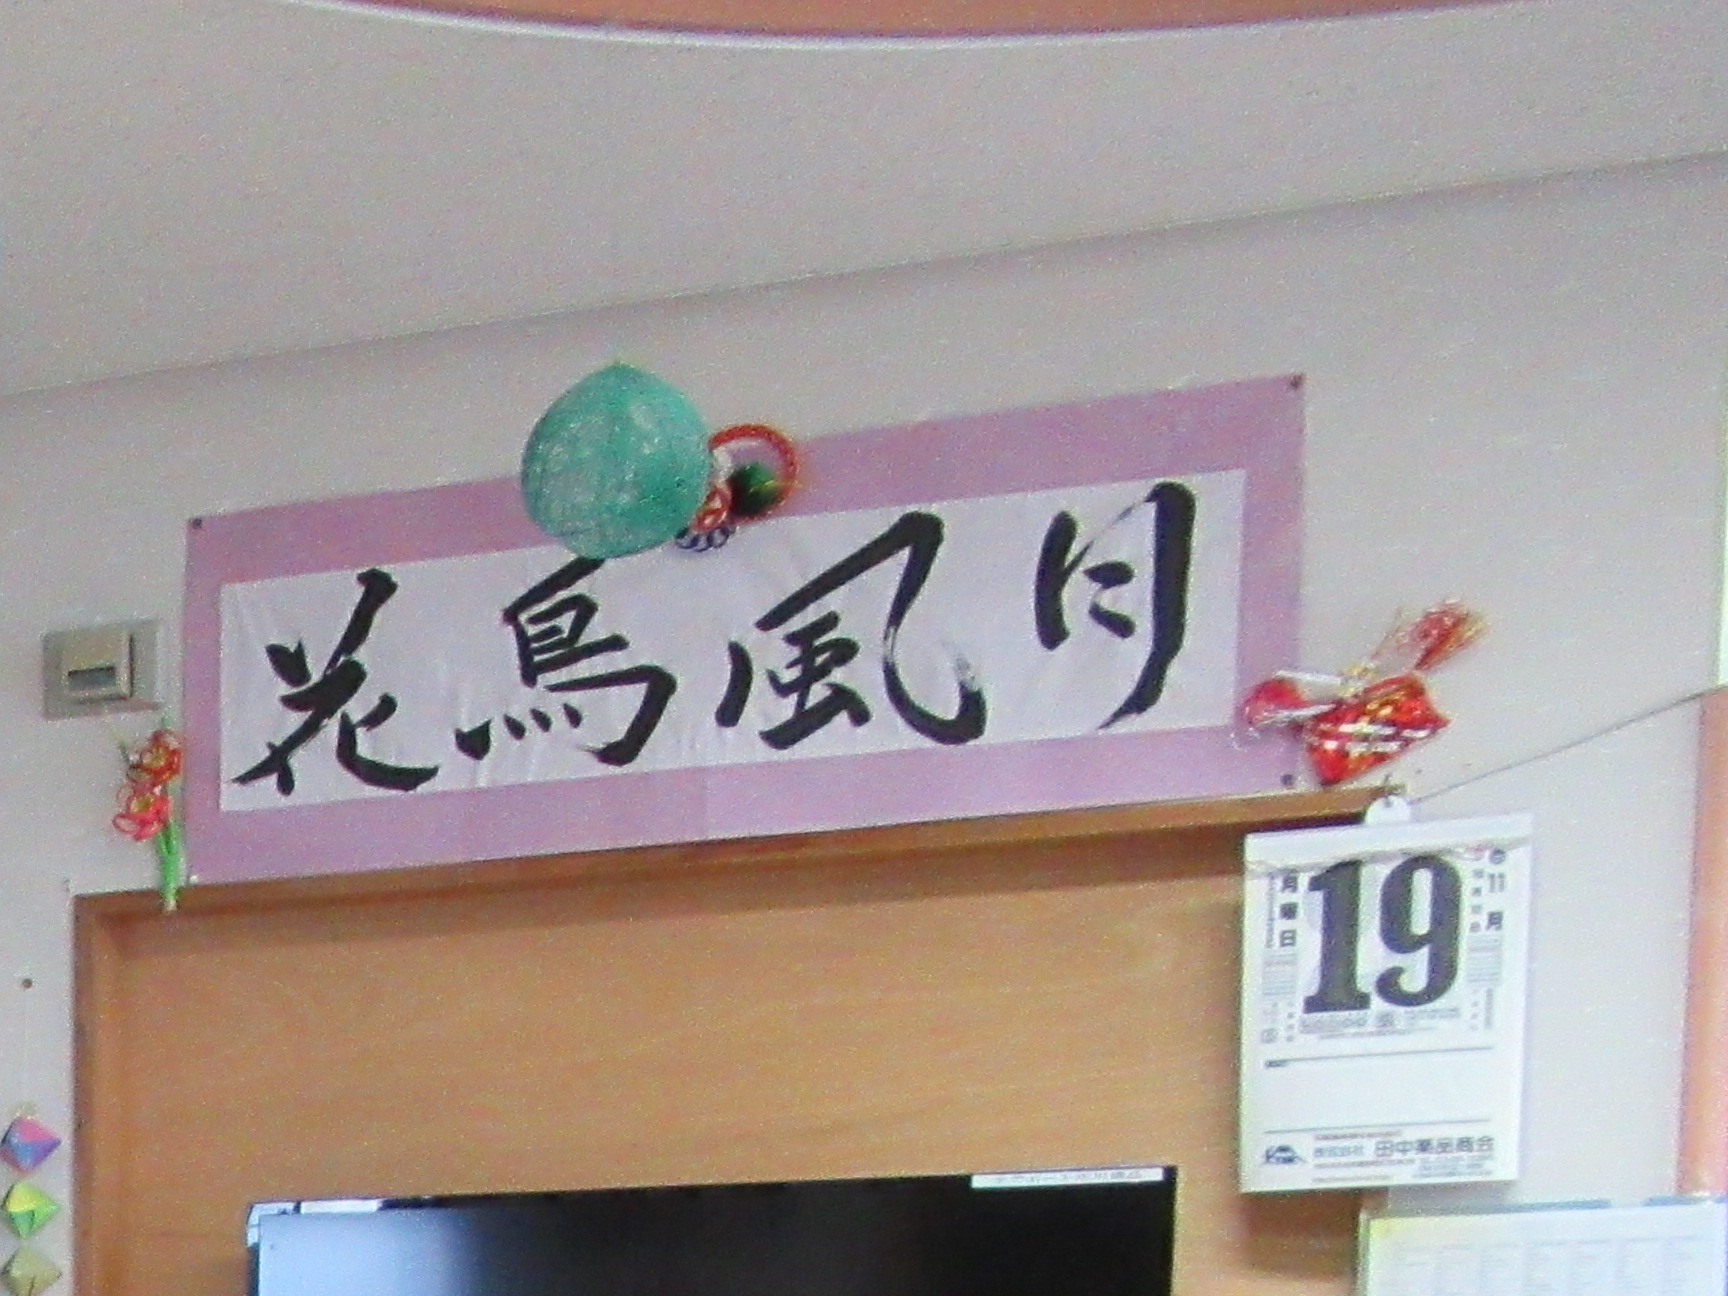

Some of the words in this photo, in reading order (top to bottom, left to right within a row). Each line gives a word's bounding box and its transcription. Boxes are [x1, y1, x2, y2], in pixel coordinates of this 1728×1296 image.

[232, 478, 1202, 798] 花鳥風月
[1279, 869, 1298, 948] 月曜日
[1303, 855, 1462, 1014] 19
